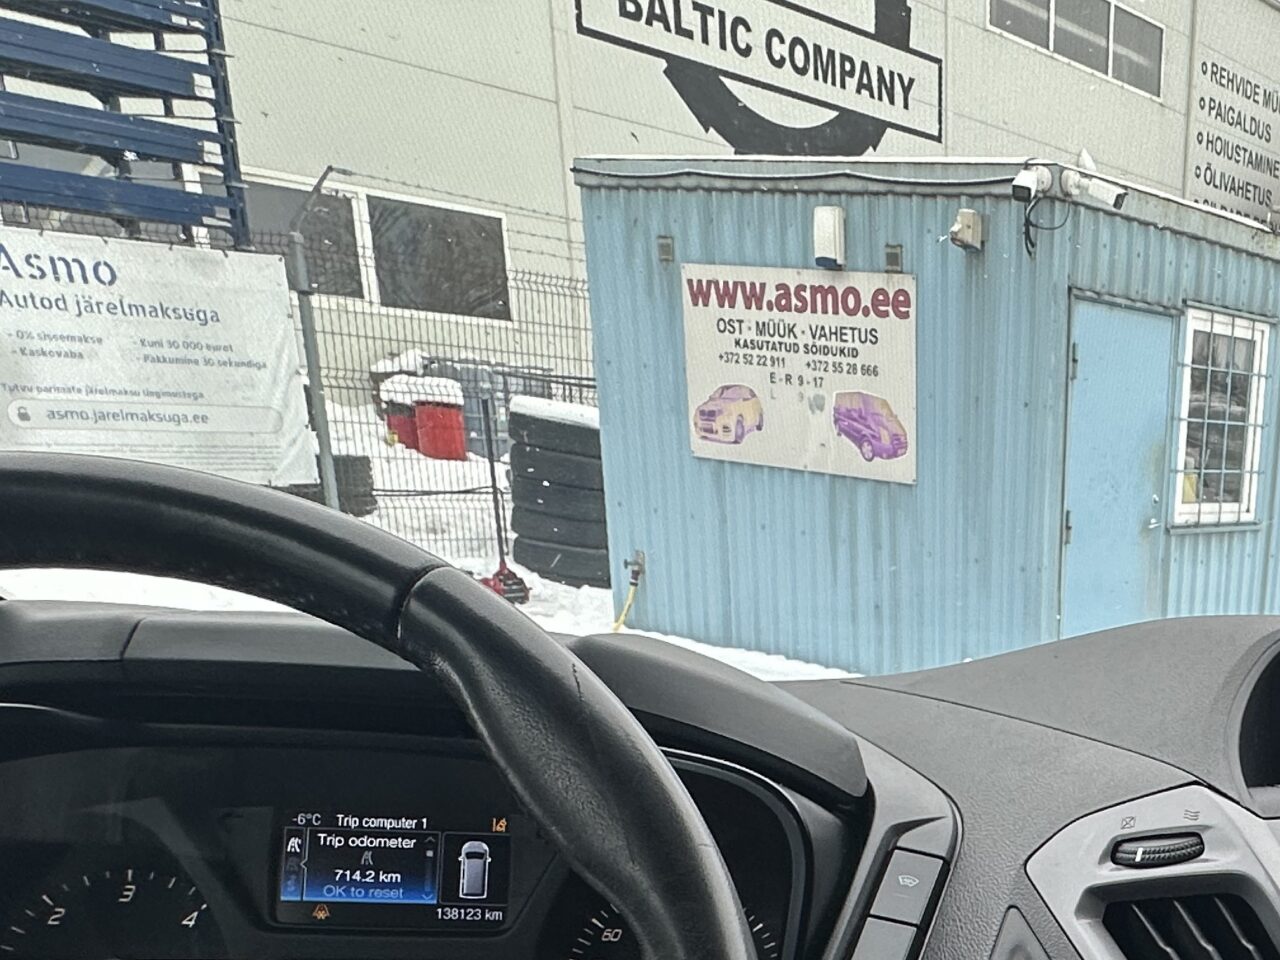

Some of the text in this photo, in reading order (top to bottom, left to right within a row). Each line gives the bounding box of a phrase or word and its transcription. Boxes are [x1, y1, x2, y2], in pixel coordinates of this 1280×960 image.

[765, 28, 915, 110] COMPANY
[1210, 62, 1260, 104] REHVIDE
[1208, 97, 1271, 143] PAIGALDUS
[1206, 131, 1280, 179] HOIUSTAMINE
[1204, 162, 1273, 208] ÕLIVAHETUS
[686, 278, 912, 320] www.asmo.ee
[75, 294, 220, 326] järelmaksuga
[716, 318, 879, 345] OST MÜÜK VAHETUS
[734, 338, 859, 359] KASUTATUD SÕIDUKID
[718, 352, 786, 368] +372 52 22 911
[805, 359, 829, 372] +372
[813, 376, 824, 388] 17
[292, 813, 321, 826] -6°C
[336, 814, 427, 830] Trip computer 1
[317, 833, 416, 848] Trip odometer
[335, 869, 401, 883] 714.2 km
[118, 885, 136, 902] 3
[323, 885, 404, 898] OK to reset
[47, 908, 66, 925] 2
[181, 911, 199, 928] 4
[436, 908, 502, 921] 138123 km
[601, 929, 622, 942] 60
